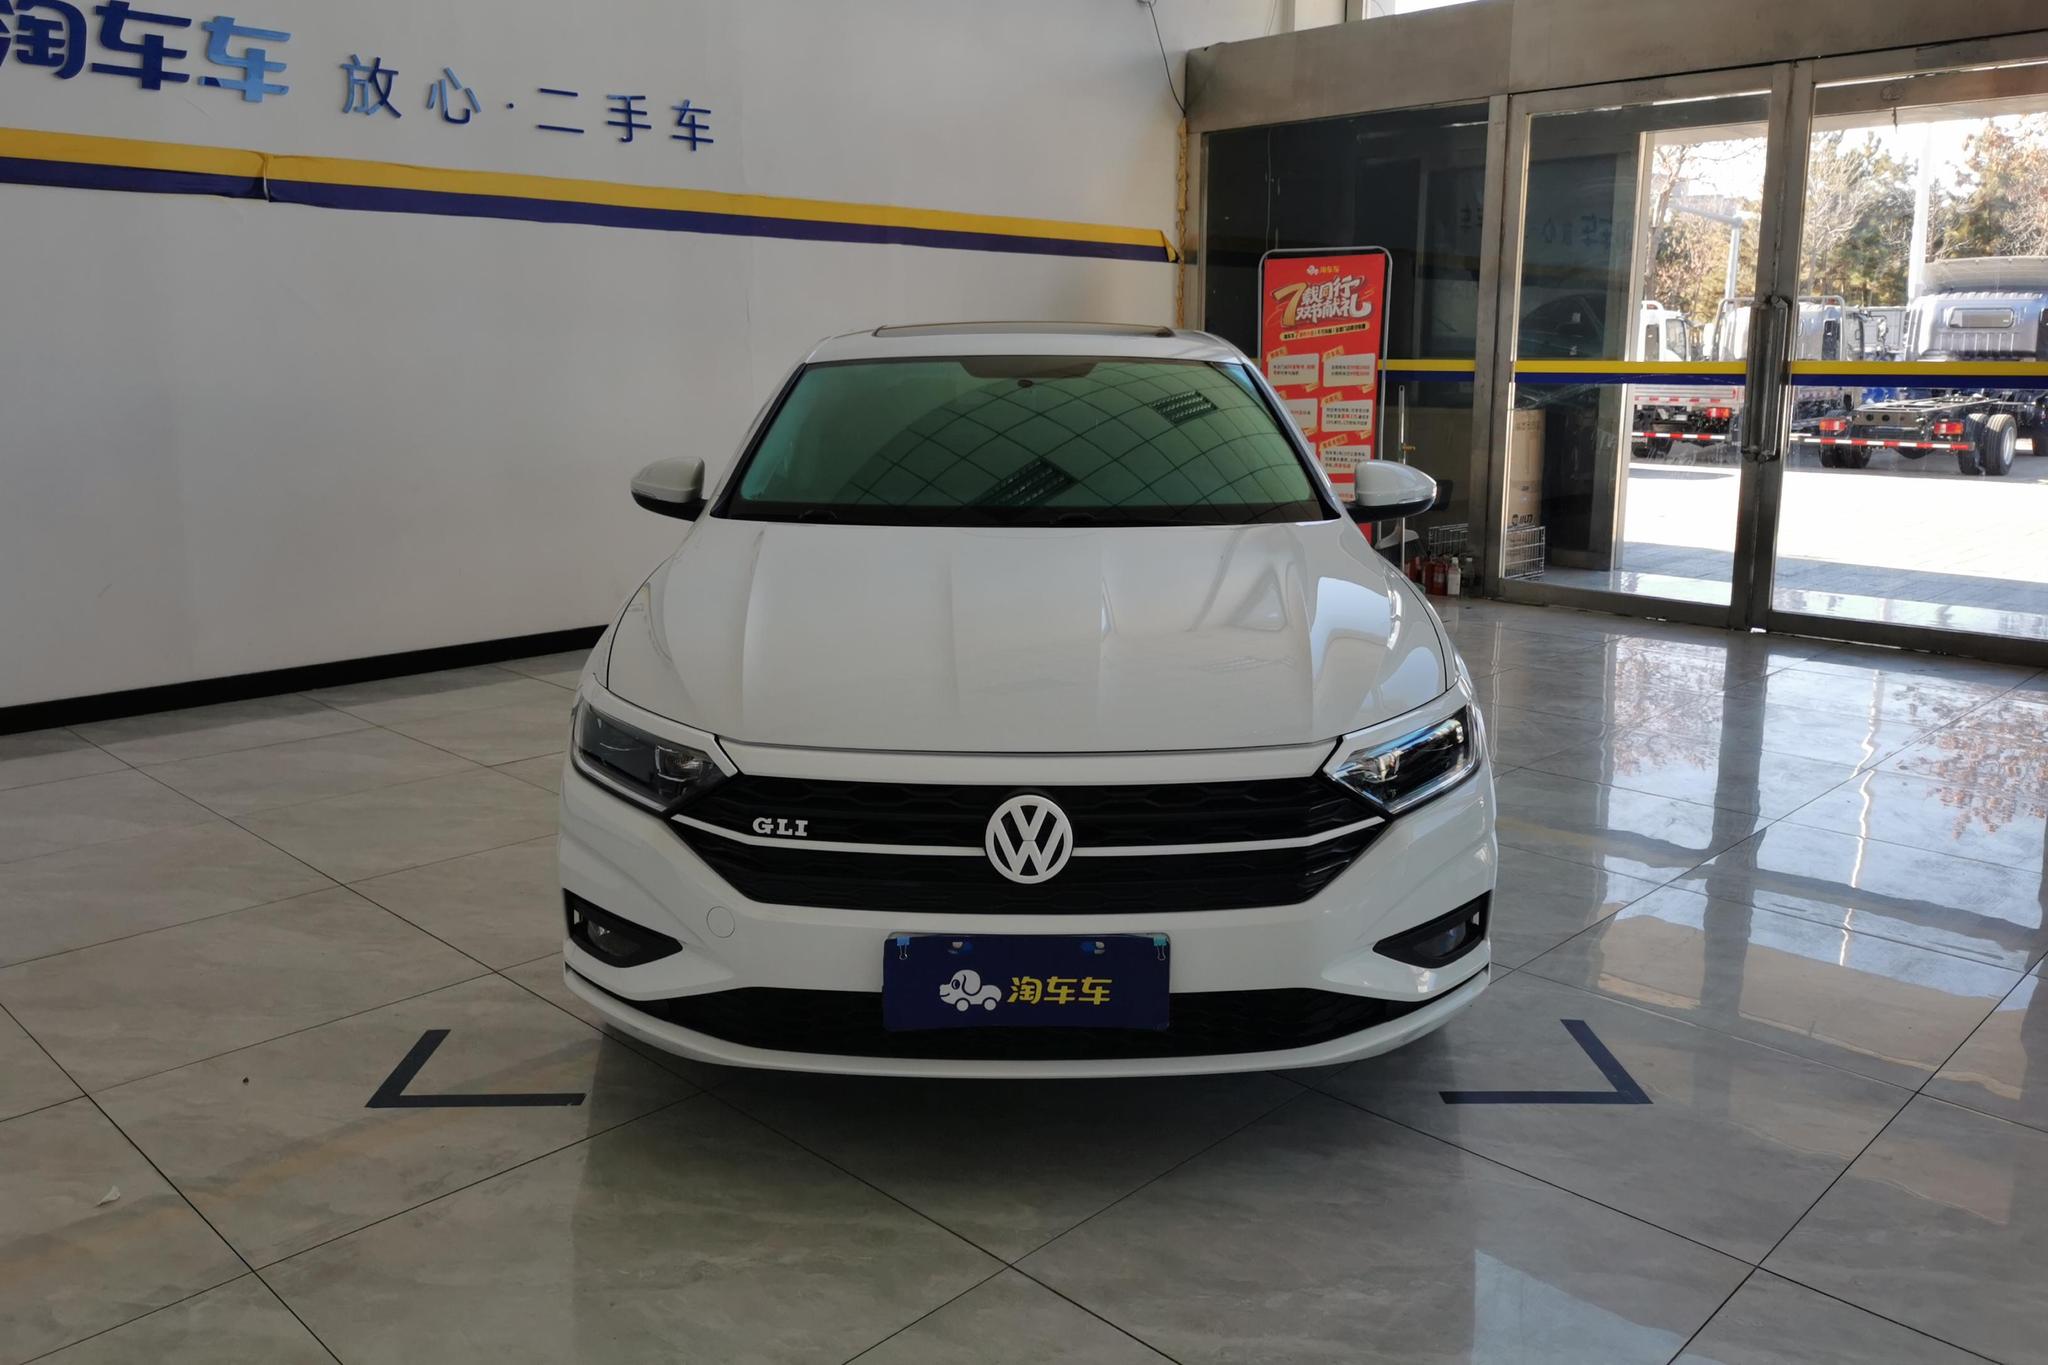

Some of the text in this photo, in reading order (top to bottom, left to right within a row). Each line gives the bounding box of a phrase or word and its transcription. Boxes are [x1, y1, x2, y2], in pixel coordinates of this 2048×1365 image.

[0, 0, 292, 103] 淘车车
[1295, 293, 1372, 324] 双节献礼
[752, 816, 809, 837] GLI
[1007, 975, 1113, 1005] 淘车车
